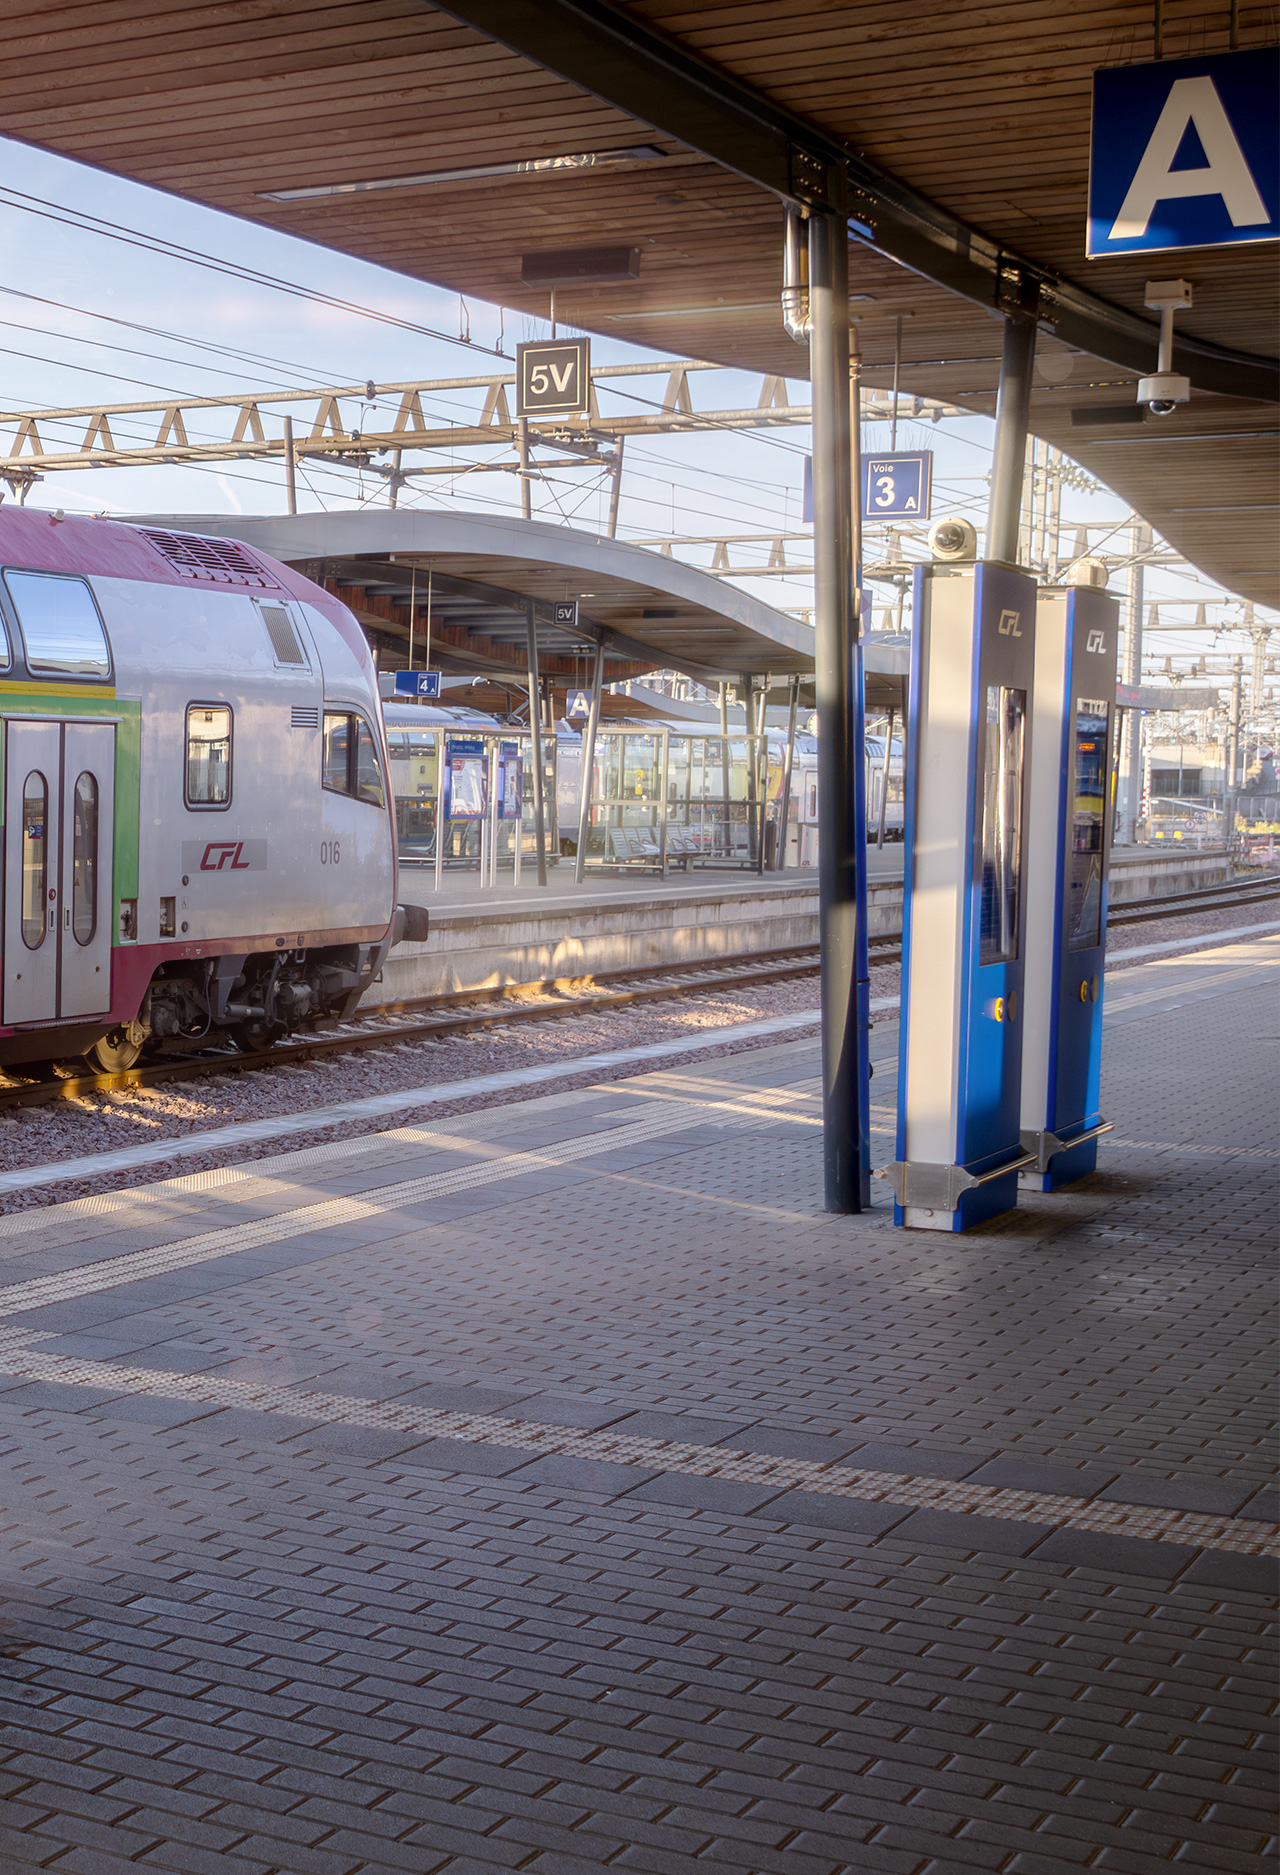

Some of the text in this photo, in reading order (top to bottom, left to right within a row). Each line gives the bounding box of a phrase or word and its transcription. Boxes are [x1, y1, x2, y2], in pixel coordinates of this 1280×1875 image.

[1108, 75, 1271, 240] A
[530, 362, 574, 394] 5V
[873, 464, 894, 473] Voie
[875, 476, 917, 509] 3 A
[558, 609, 572, 619] 5V
[998, 609, 1022, 638] CFL
[1086, 629, 1107, 655] CFL
[420, 680, 428, 691] 4
[569, 692, 590, 716] A
[200, 842, 250, 870] CFL
[320, 841, 340, 865] 016
